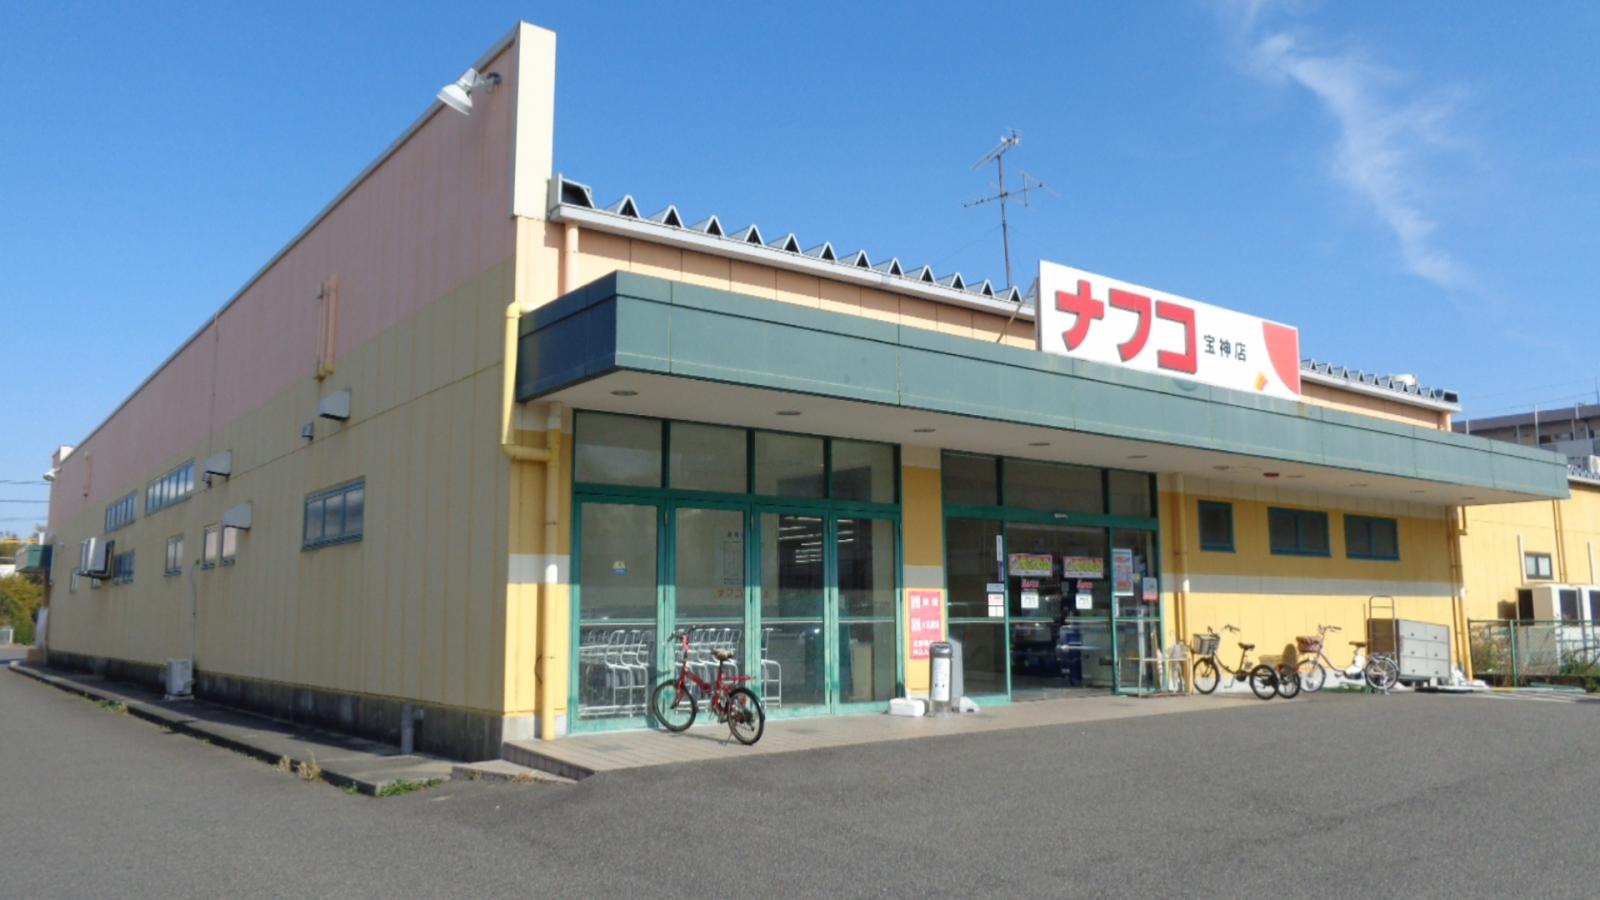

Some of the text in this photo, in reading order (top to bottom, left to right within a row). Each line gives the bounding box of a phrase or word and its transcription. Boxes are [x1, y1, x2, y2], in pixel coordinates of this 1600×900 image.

[1055, 280, 1246, 374] ナフコ 宝神店
